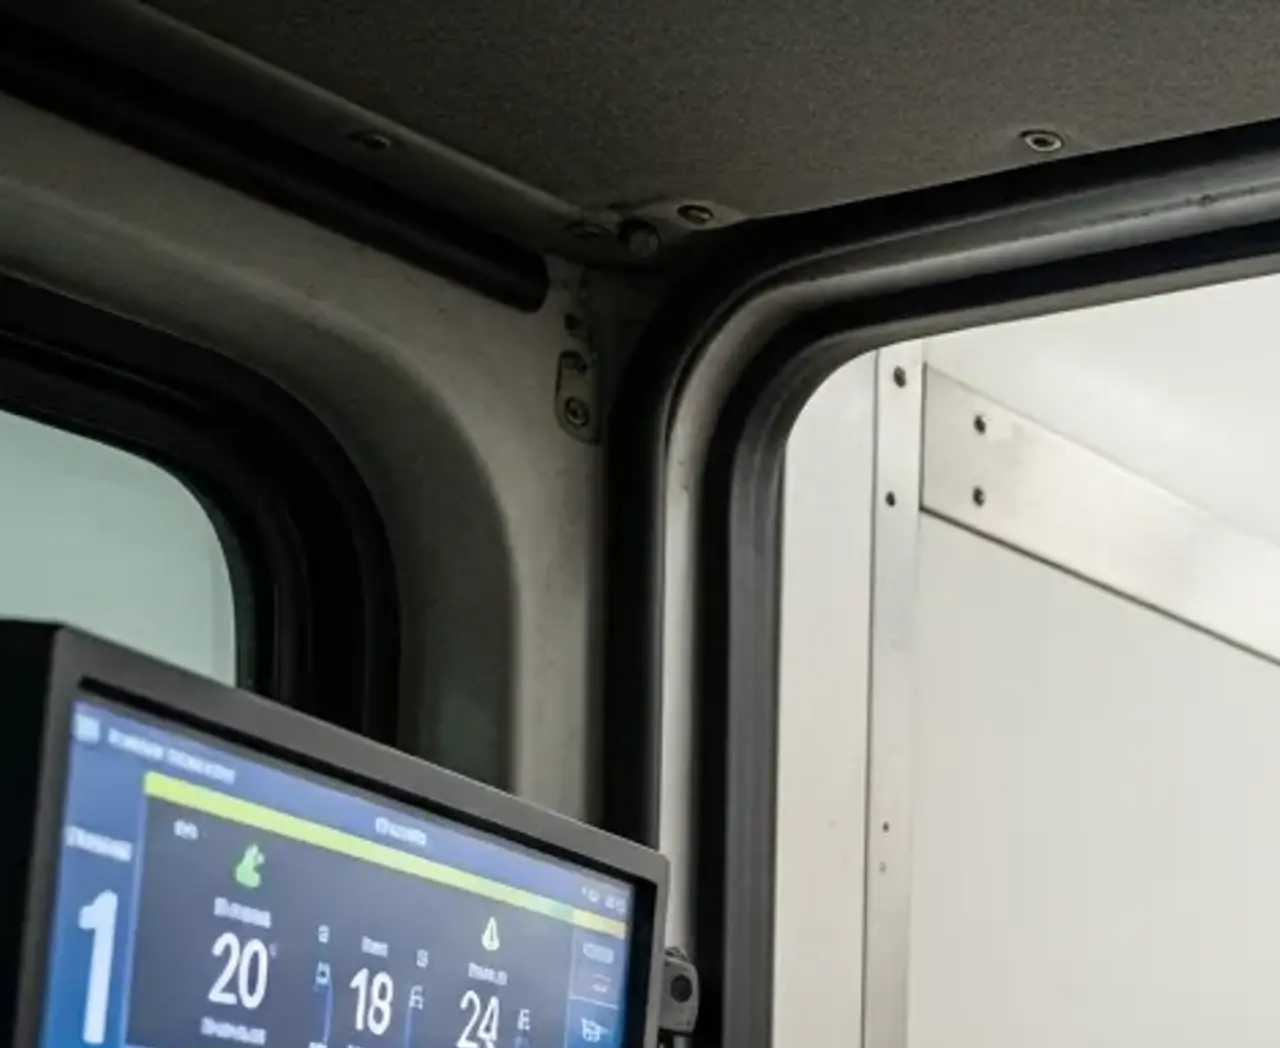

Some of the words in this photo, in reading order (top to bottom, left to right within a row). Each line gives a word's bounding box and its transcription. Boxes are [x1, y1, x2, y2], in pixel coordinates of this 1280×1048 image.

[78, 890, 118, 1045] 1
[208, 932, 268, 1009] 20
[350, 967, 394, 1035] 18
